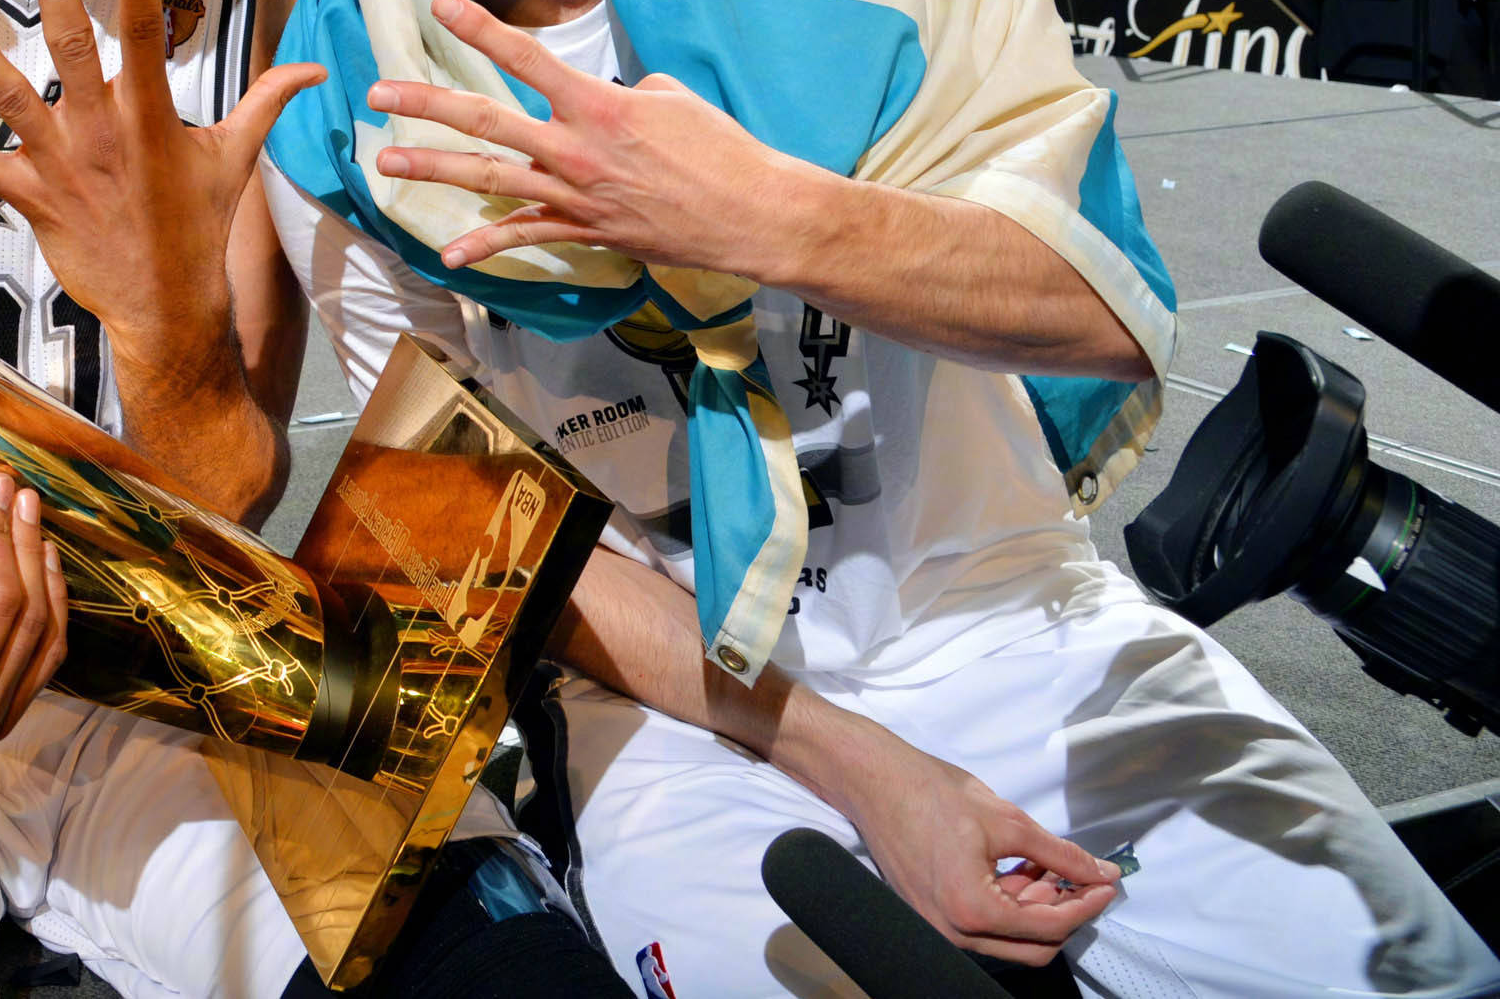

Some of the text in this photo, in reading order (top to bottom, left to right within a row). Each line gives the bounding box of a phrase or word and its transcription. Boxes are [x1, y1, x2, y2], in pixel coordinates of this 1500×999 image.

[592, 395, 647, 426] ROOM
[596, 411, 651, 444] EDITION
[515, 484, 541, 521] NBA
